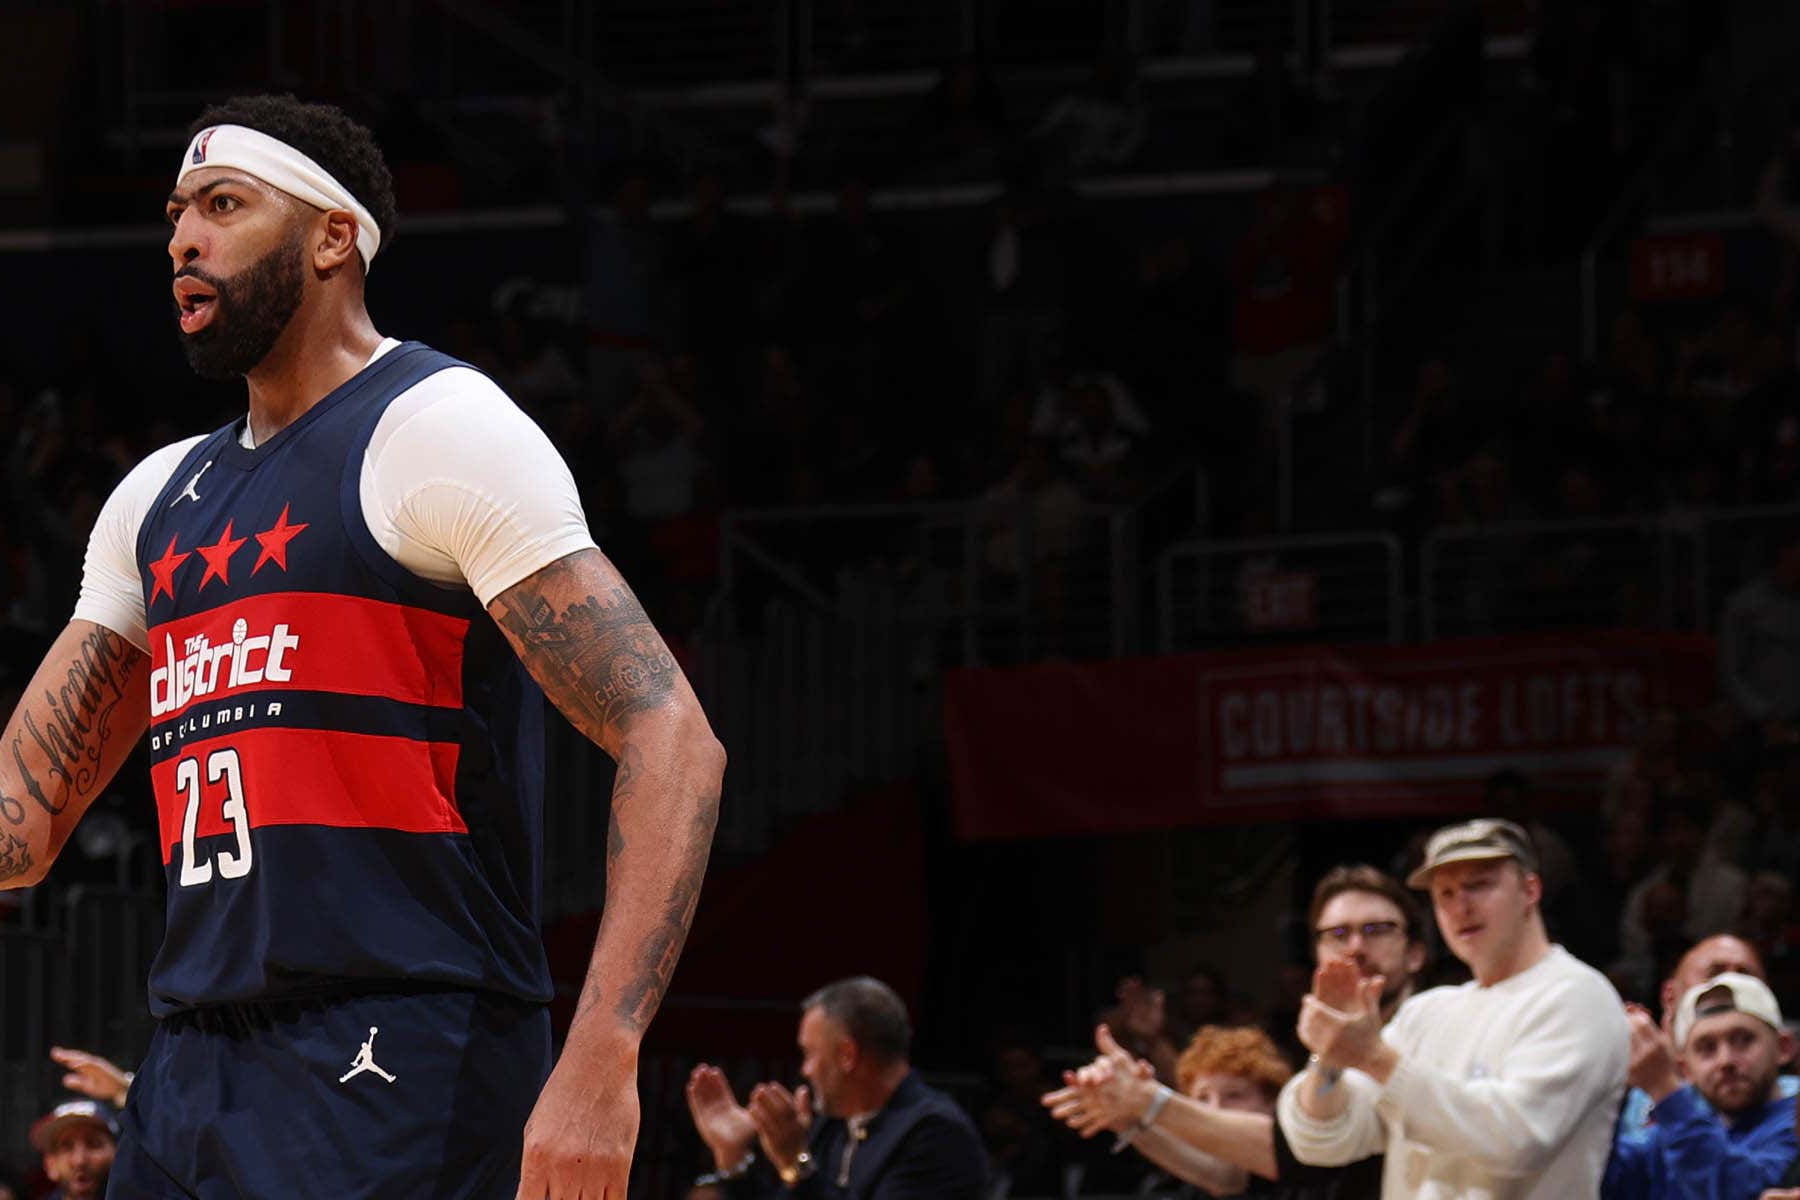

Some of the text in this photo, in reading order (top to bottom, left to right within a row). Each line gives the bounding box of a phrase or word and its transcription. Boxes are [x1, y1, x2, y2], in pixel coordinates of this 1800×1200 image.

[594, 651, 673, 705] CHICAGO
[1219, 668, 1646, 760] COURTSIDE LOFTS
[151, 702, 282, 751] OF CLUMBIA
[177, 749, 252, 887] 23
